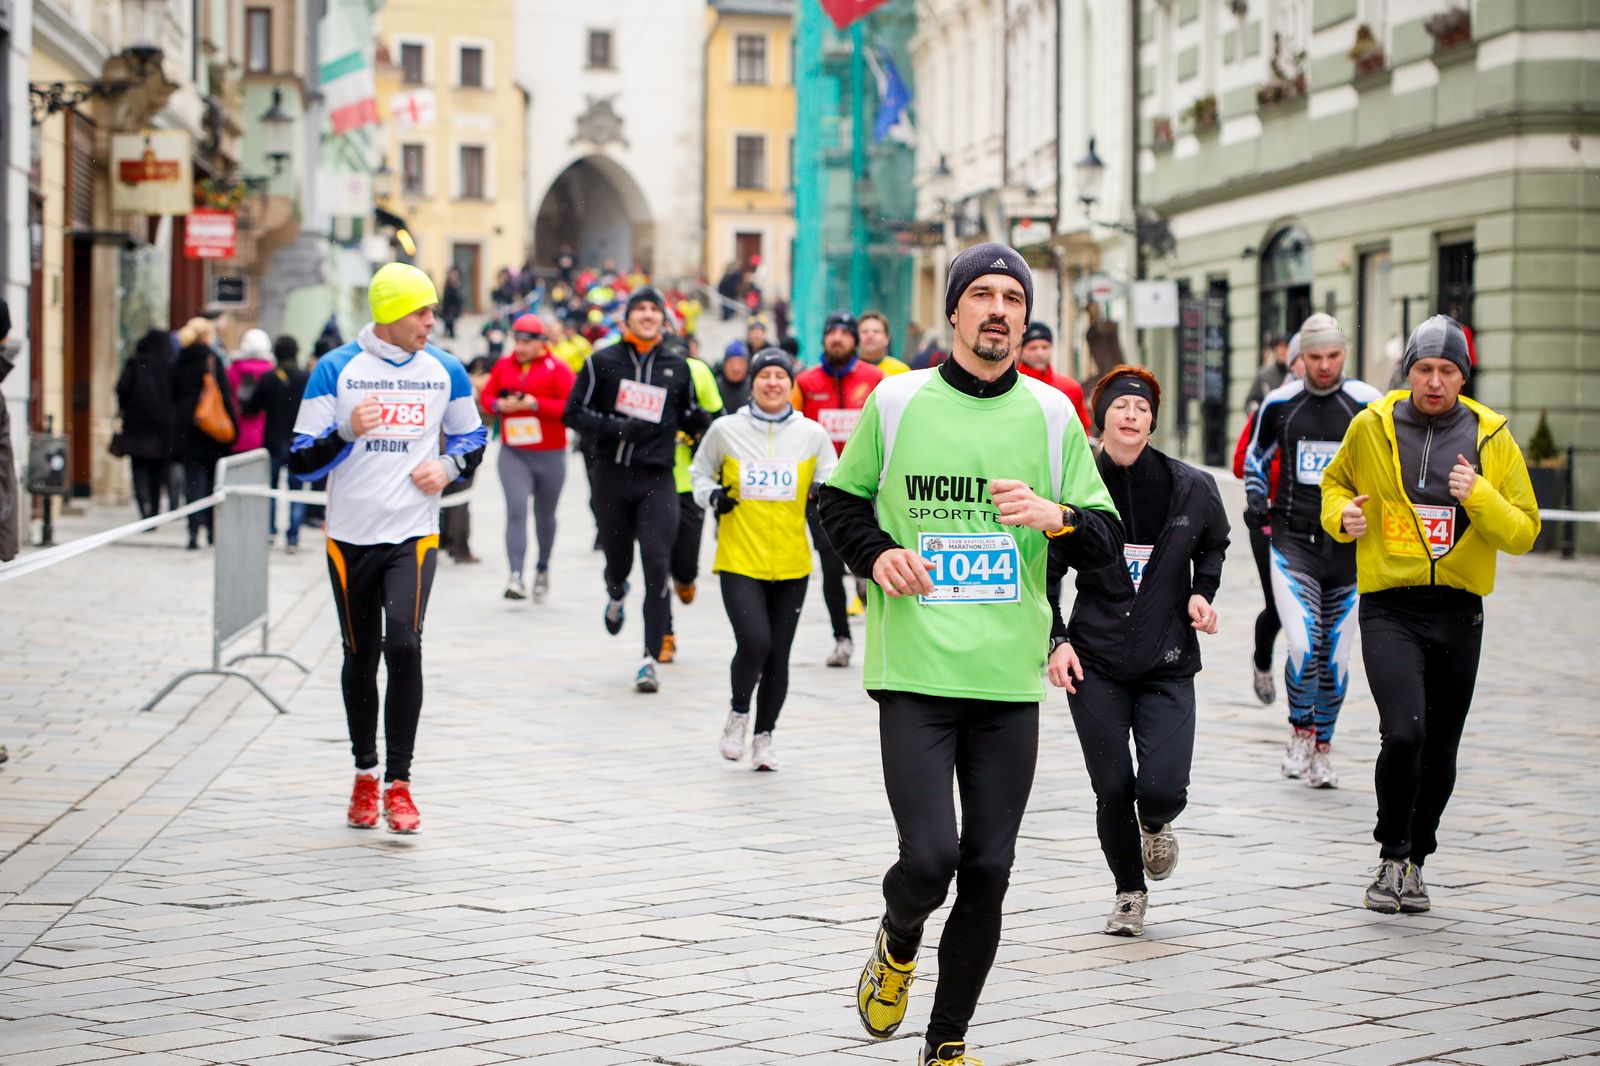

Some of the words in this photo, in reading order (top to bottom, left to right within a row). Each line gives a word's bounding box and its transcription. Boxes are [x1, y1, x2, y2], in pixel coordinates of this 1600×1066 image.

[347, 380, 394, 390] Schnelle
[746, 470, 792, 486] 5210
[909, 507, 976, 520] SPORT
[930, 553, 1014, 581] 1044
